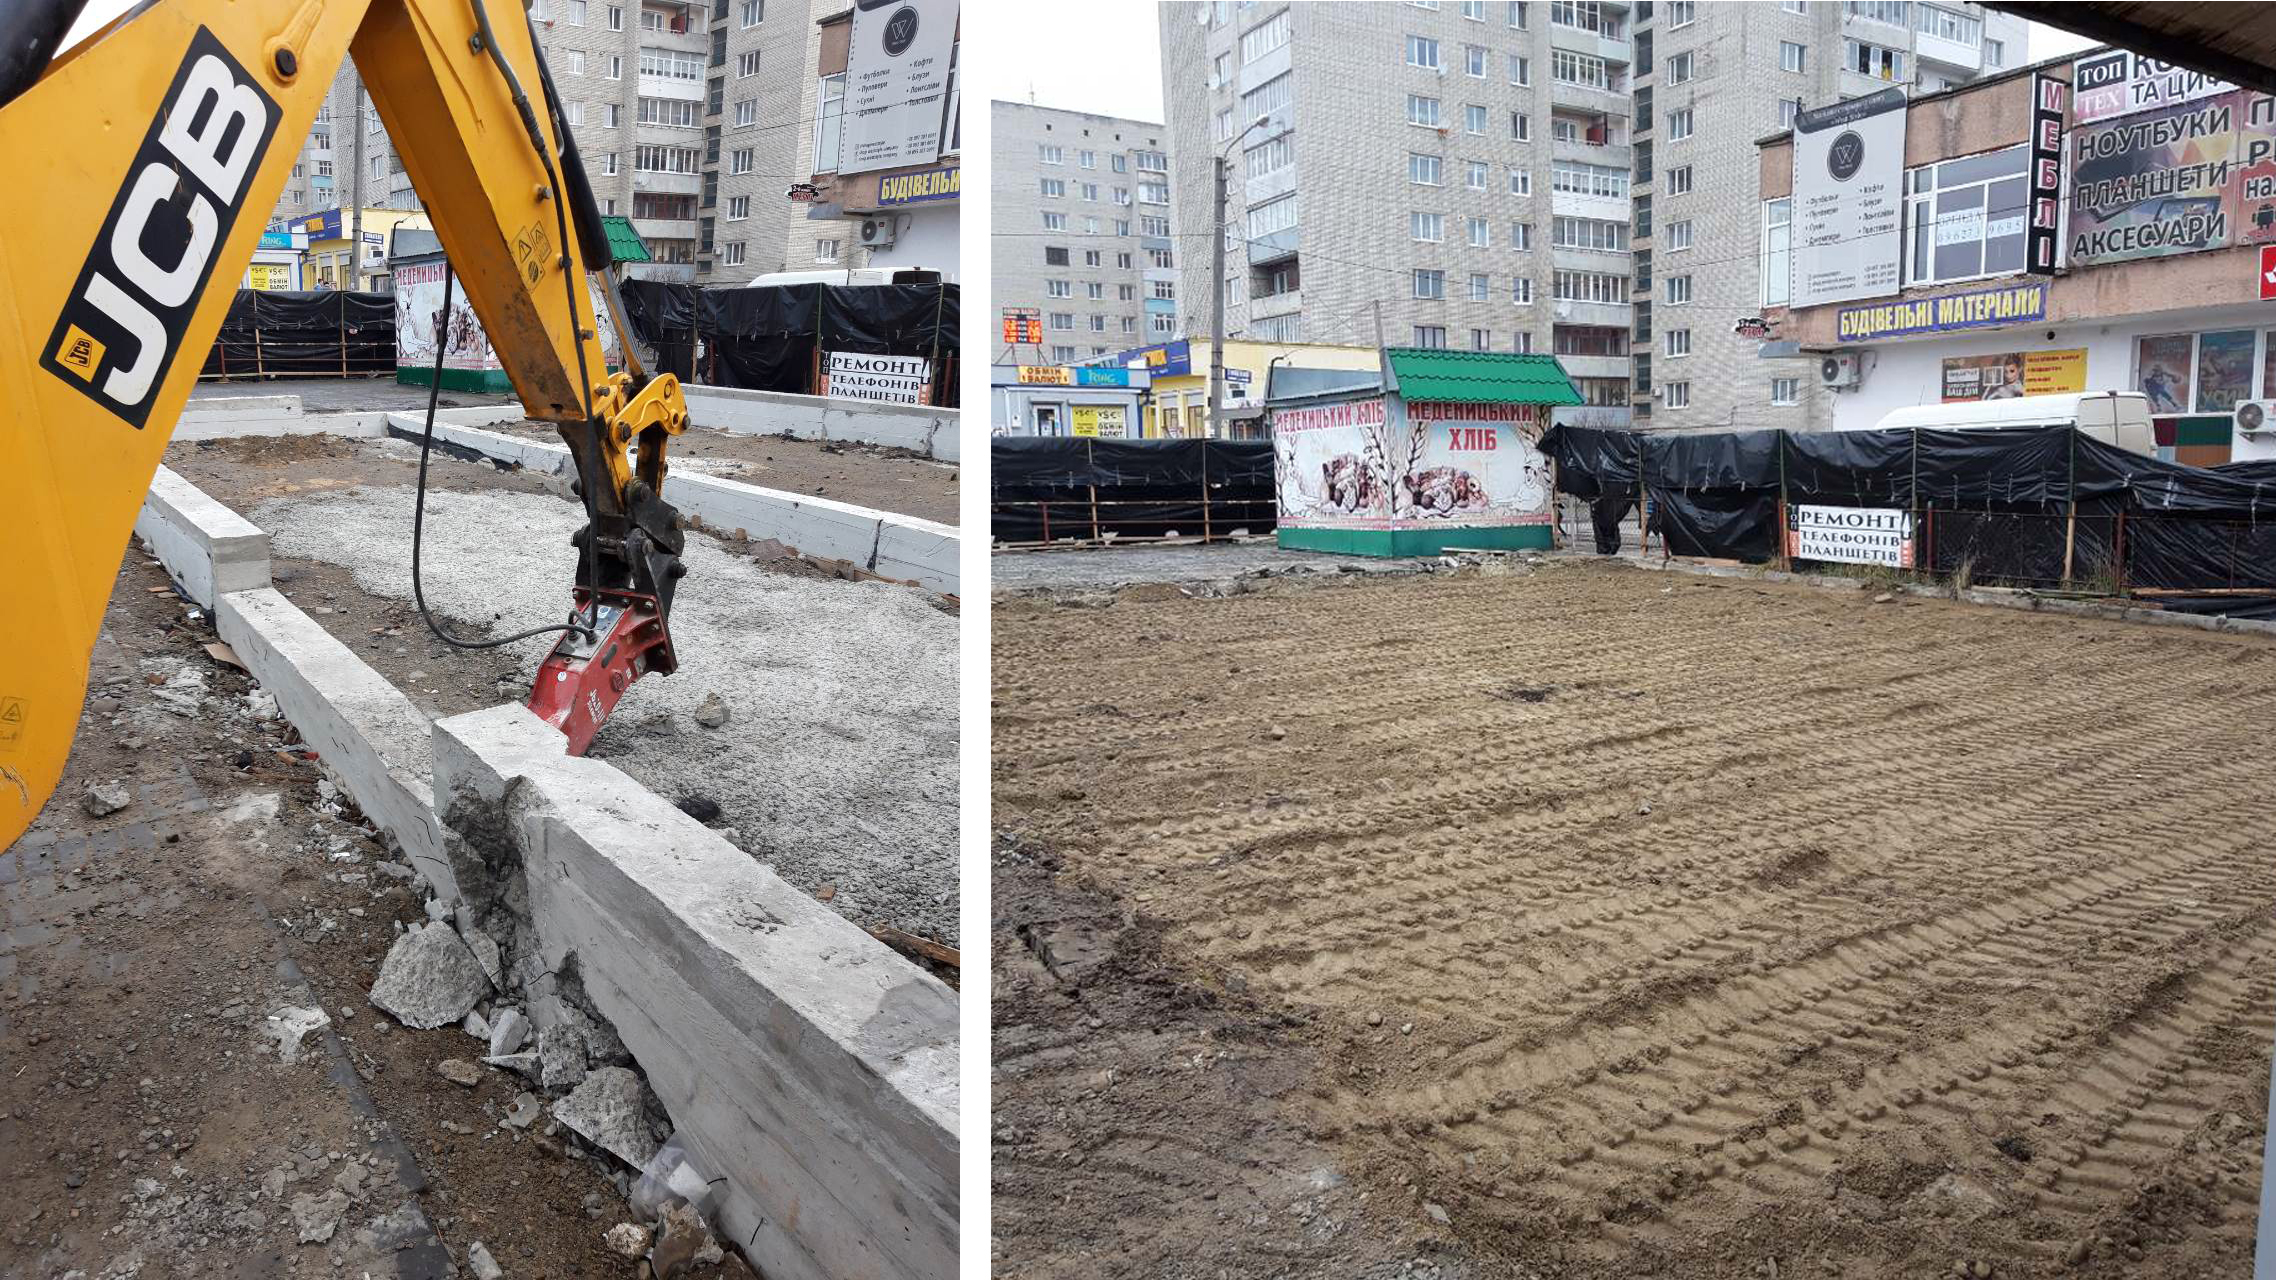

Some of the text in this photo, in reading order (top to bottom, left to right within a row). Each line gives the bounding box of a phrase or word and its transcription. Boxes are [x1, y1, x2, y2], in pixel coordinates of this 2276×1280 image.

[2080, 60, 2122, 86] ТОП
[2080, 90, 2121, 113] ТЕХ
[2131, 81, 2160, 104] ТА
[2078, 106, 2230, 161] НОУТБУКИ
[2249, 140, 2276, 167] Р
[2033, 79, 2065, 267] МЕБЛІ
[2076, 160, 2228, 210] ПЛАНШЕТИ
[2246, 177, 2276, 199] на
[84, 54, 268, 406] JCB
[2072, 213, 2226, 258] АКСЕСУАРИ
[396, 263, 449, 286] МЕДЕНИЦЬК
[1840, 287, 2042, 337] БУДІВЕЛЬНІ МАТЕРІАЛИ
[69, 340, 91, 365] JCB
[831, 356, 922, 374] РЕМОНТ
[1026, 367, 1062, 375] ОБМІН
[831, 374, 919, 391] ТЕЛЕФОНІВ
[1027, 375, 1062, 384] ВАЛЮТ
[830, 386, 916, 404] ПЛАНШЕТІВ
[1356, 400, 1384, 426] ХЛІБ
[1448, 428, 1498, 451] ХЛІБ
[1801, 511, 1900, 529] РЕМОНТ
[1801, 530, 1900, 547] ТЕЛЕФОНІВ
[1802, 545, 1898, 561] ПЛАНШЕТІВ
